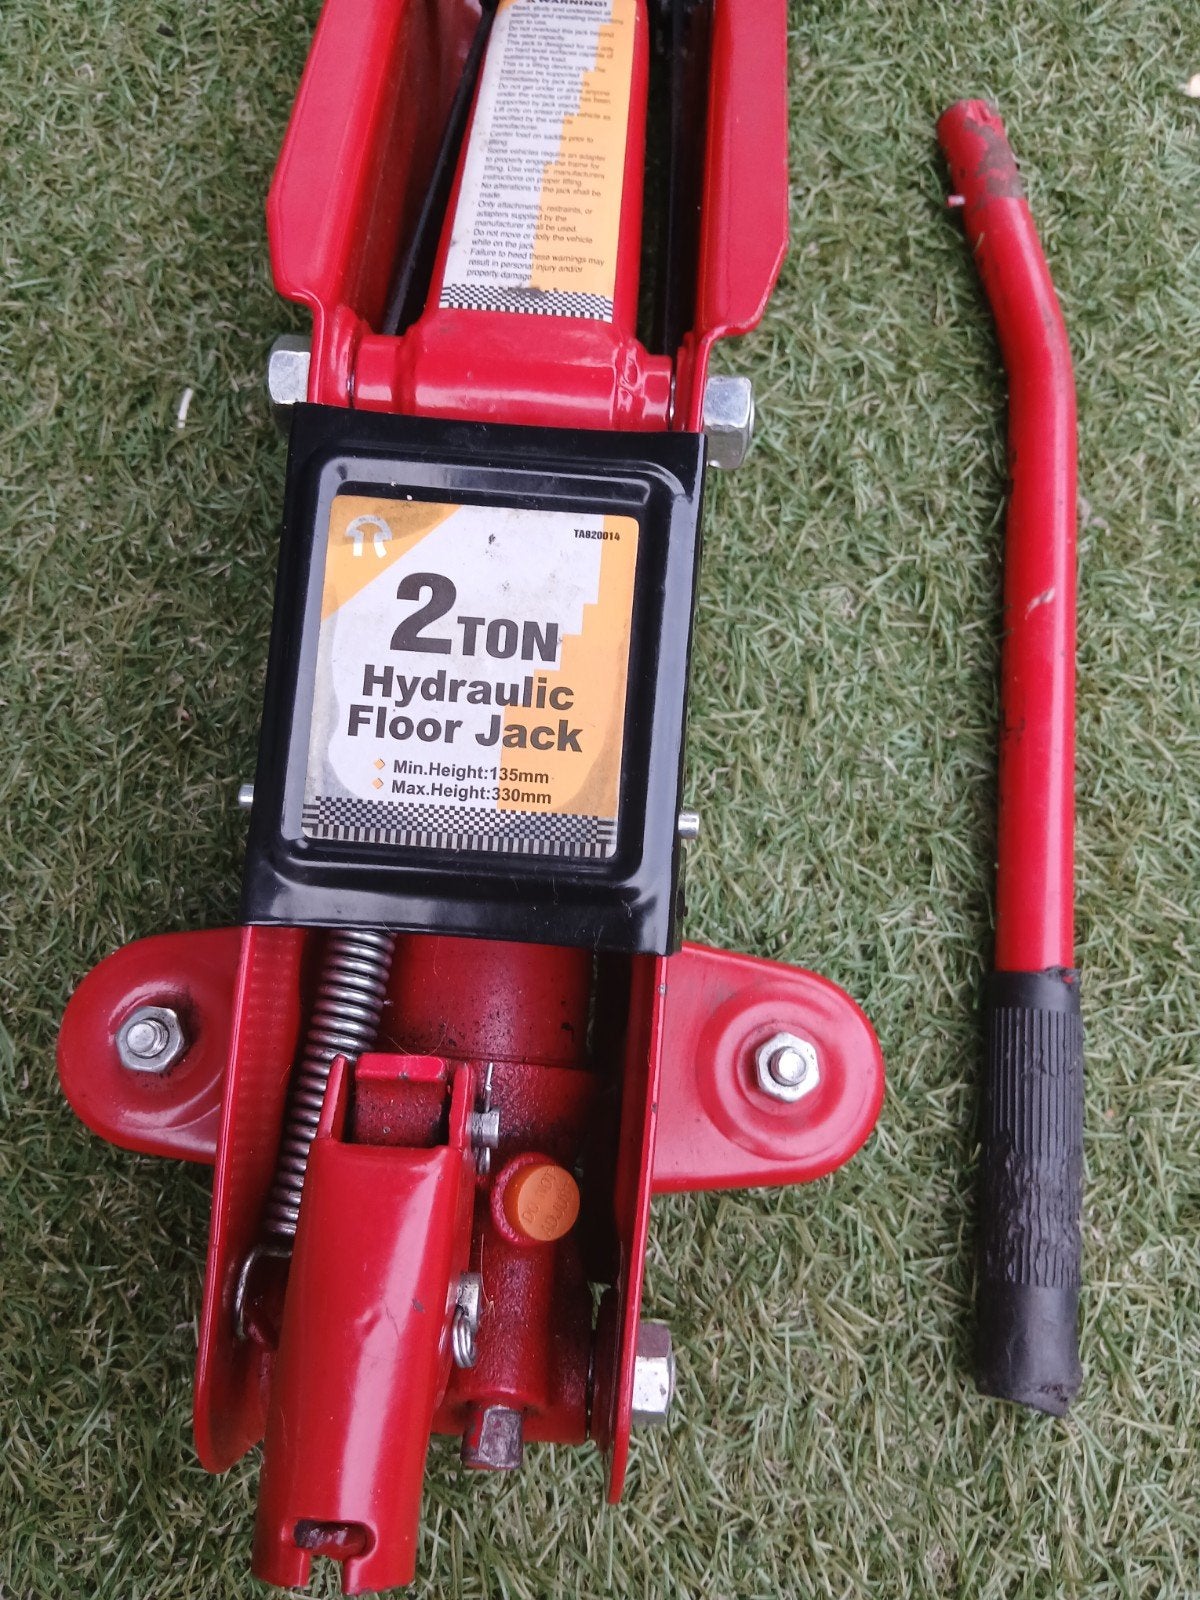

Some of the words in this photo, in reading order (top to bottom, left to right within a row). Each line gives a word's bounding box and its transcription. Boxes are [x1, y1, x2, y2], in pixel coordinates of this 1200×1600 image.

[573, 528, 620, 542] TA820014
[457, 617, 559, 662] TON
[362, 664, 574, 711] Hydraulic
[348, 704, 462, 743] Floor
[475, 715, 583, 752] Jack
